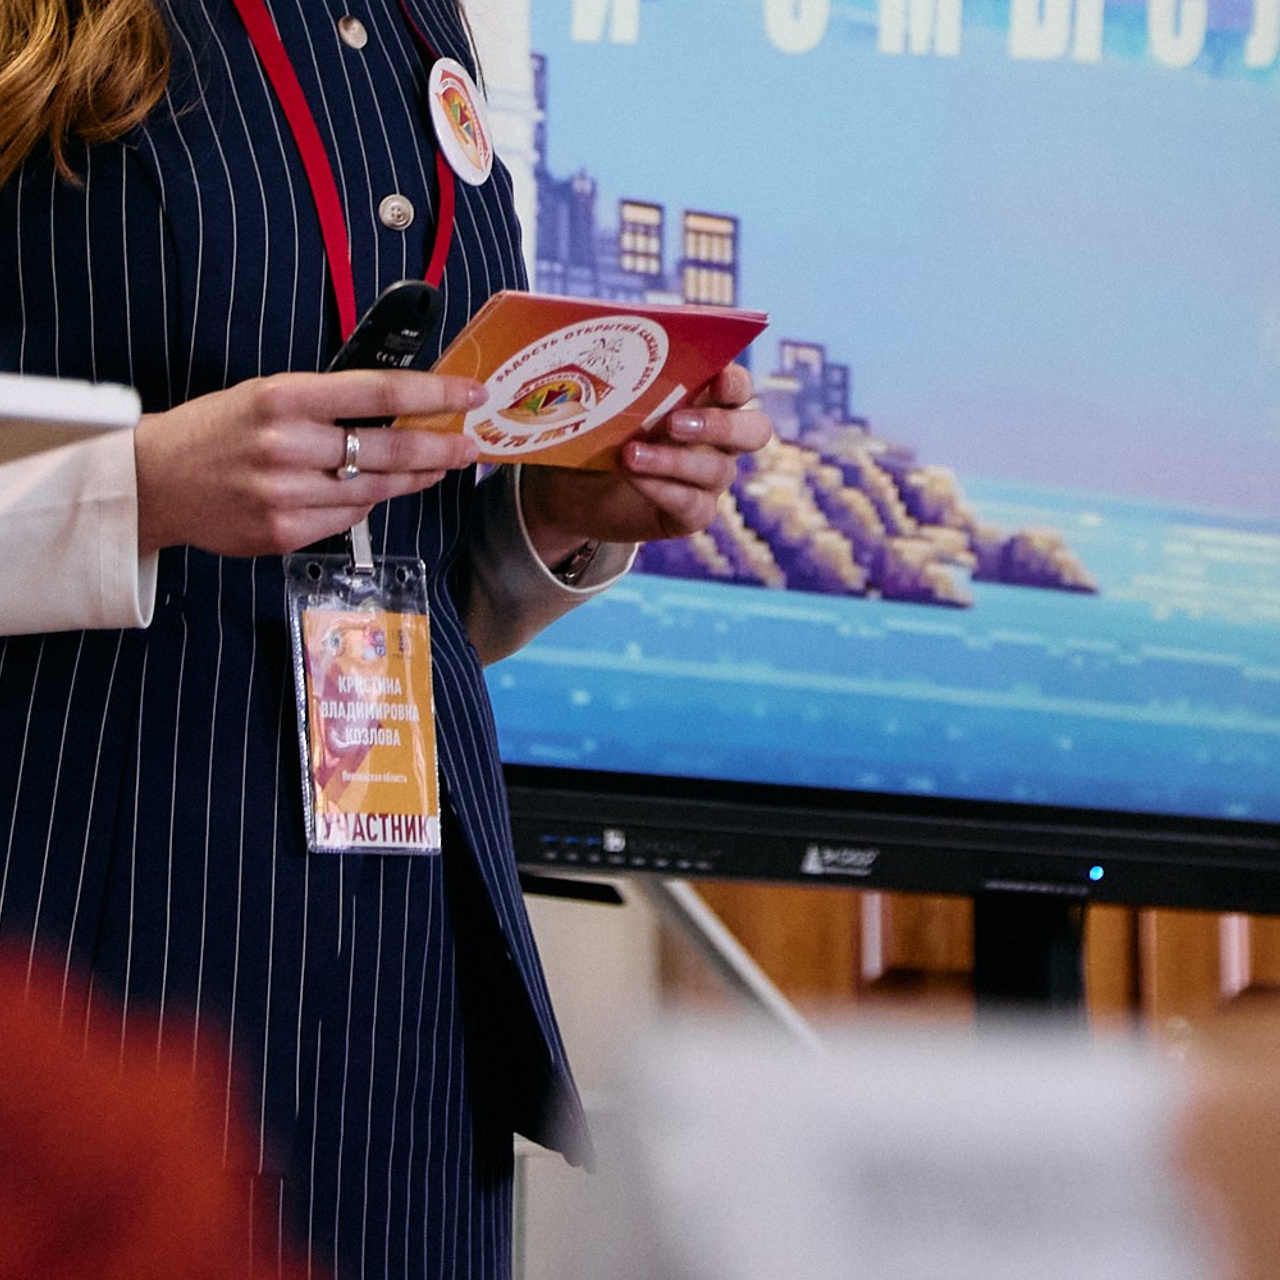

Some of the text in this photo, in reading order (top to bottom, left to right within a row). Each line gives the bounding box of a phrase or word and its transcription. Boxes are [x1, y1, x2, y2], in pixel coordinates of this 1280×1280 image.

[321, 701, 419, 722] ВЛАДИМИРОВНА
[345, 727, 401, 746] КОЗЛОВА
[323, 812, 431, 844] УЧАСТНИК
